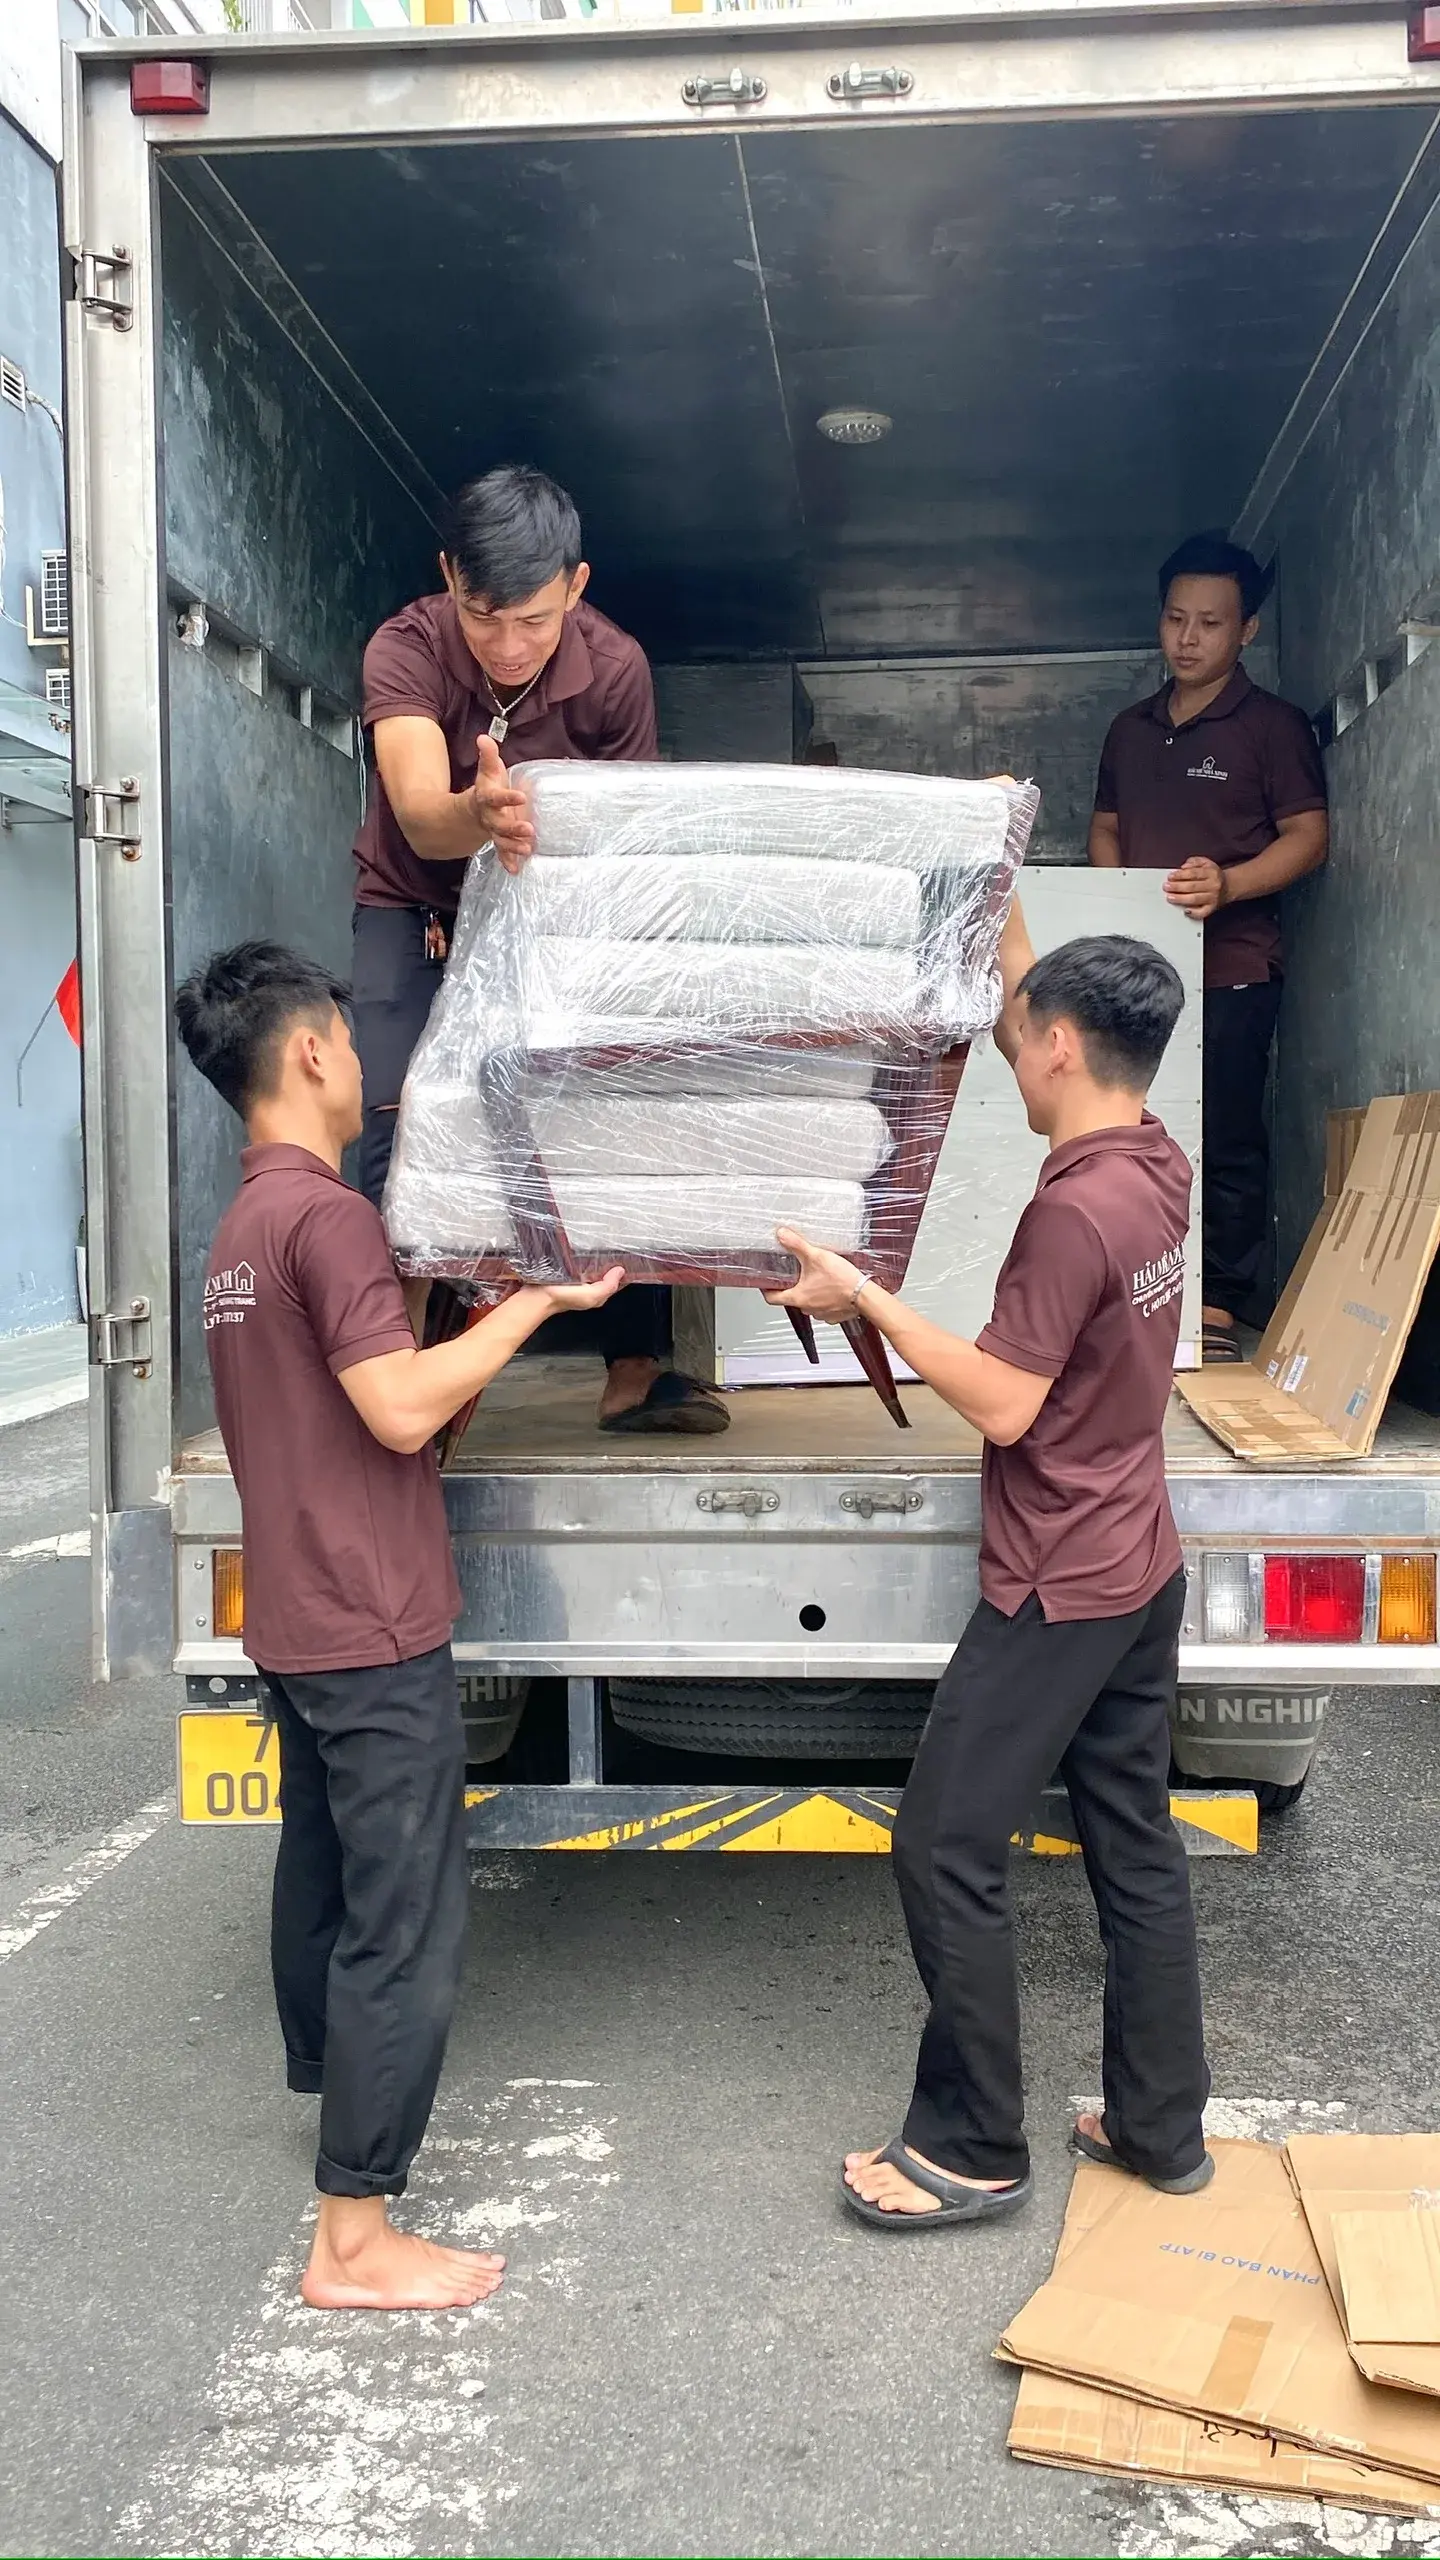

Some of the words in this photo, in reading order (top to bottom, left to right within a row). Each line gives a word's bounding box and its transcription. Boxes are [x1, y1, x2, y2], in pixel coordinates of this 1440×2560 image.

[207, 1772, 280, 1817] 00
[1158, 2242, 1196, 2256] ATP
[1220, 2255, 1263, 2272] BAO
